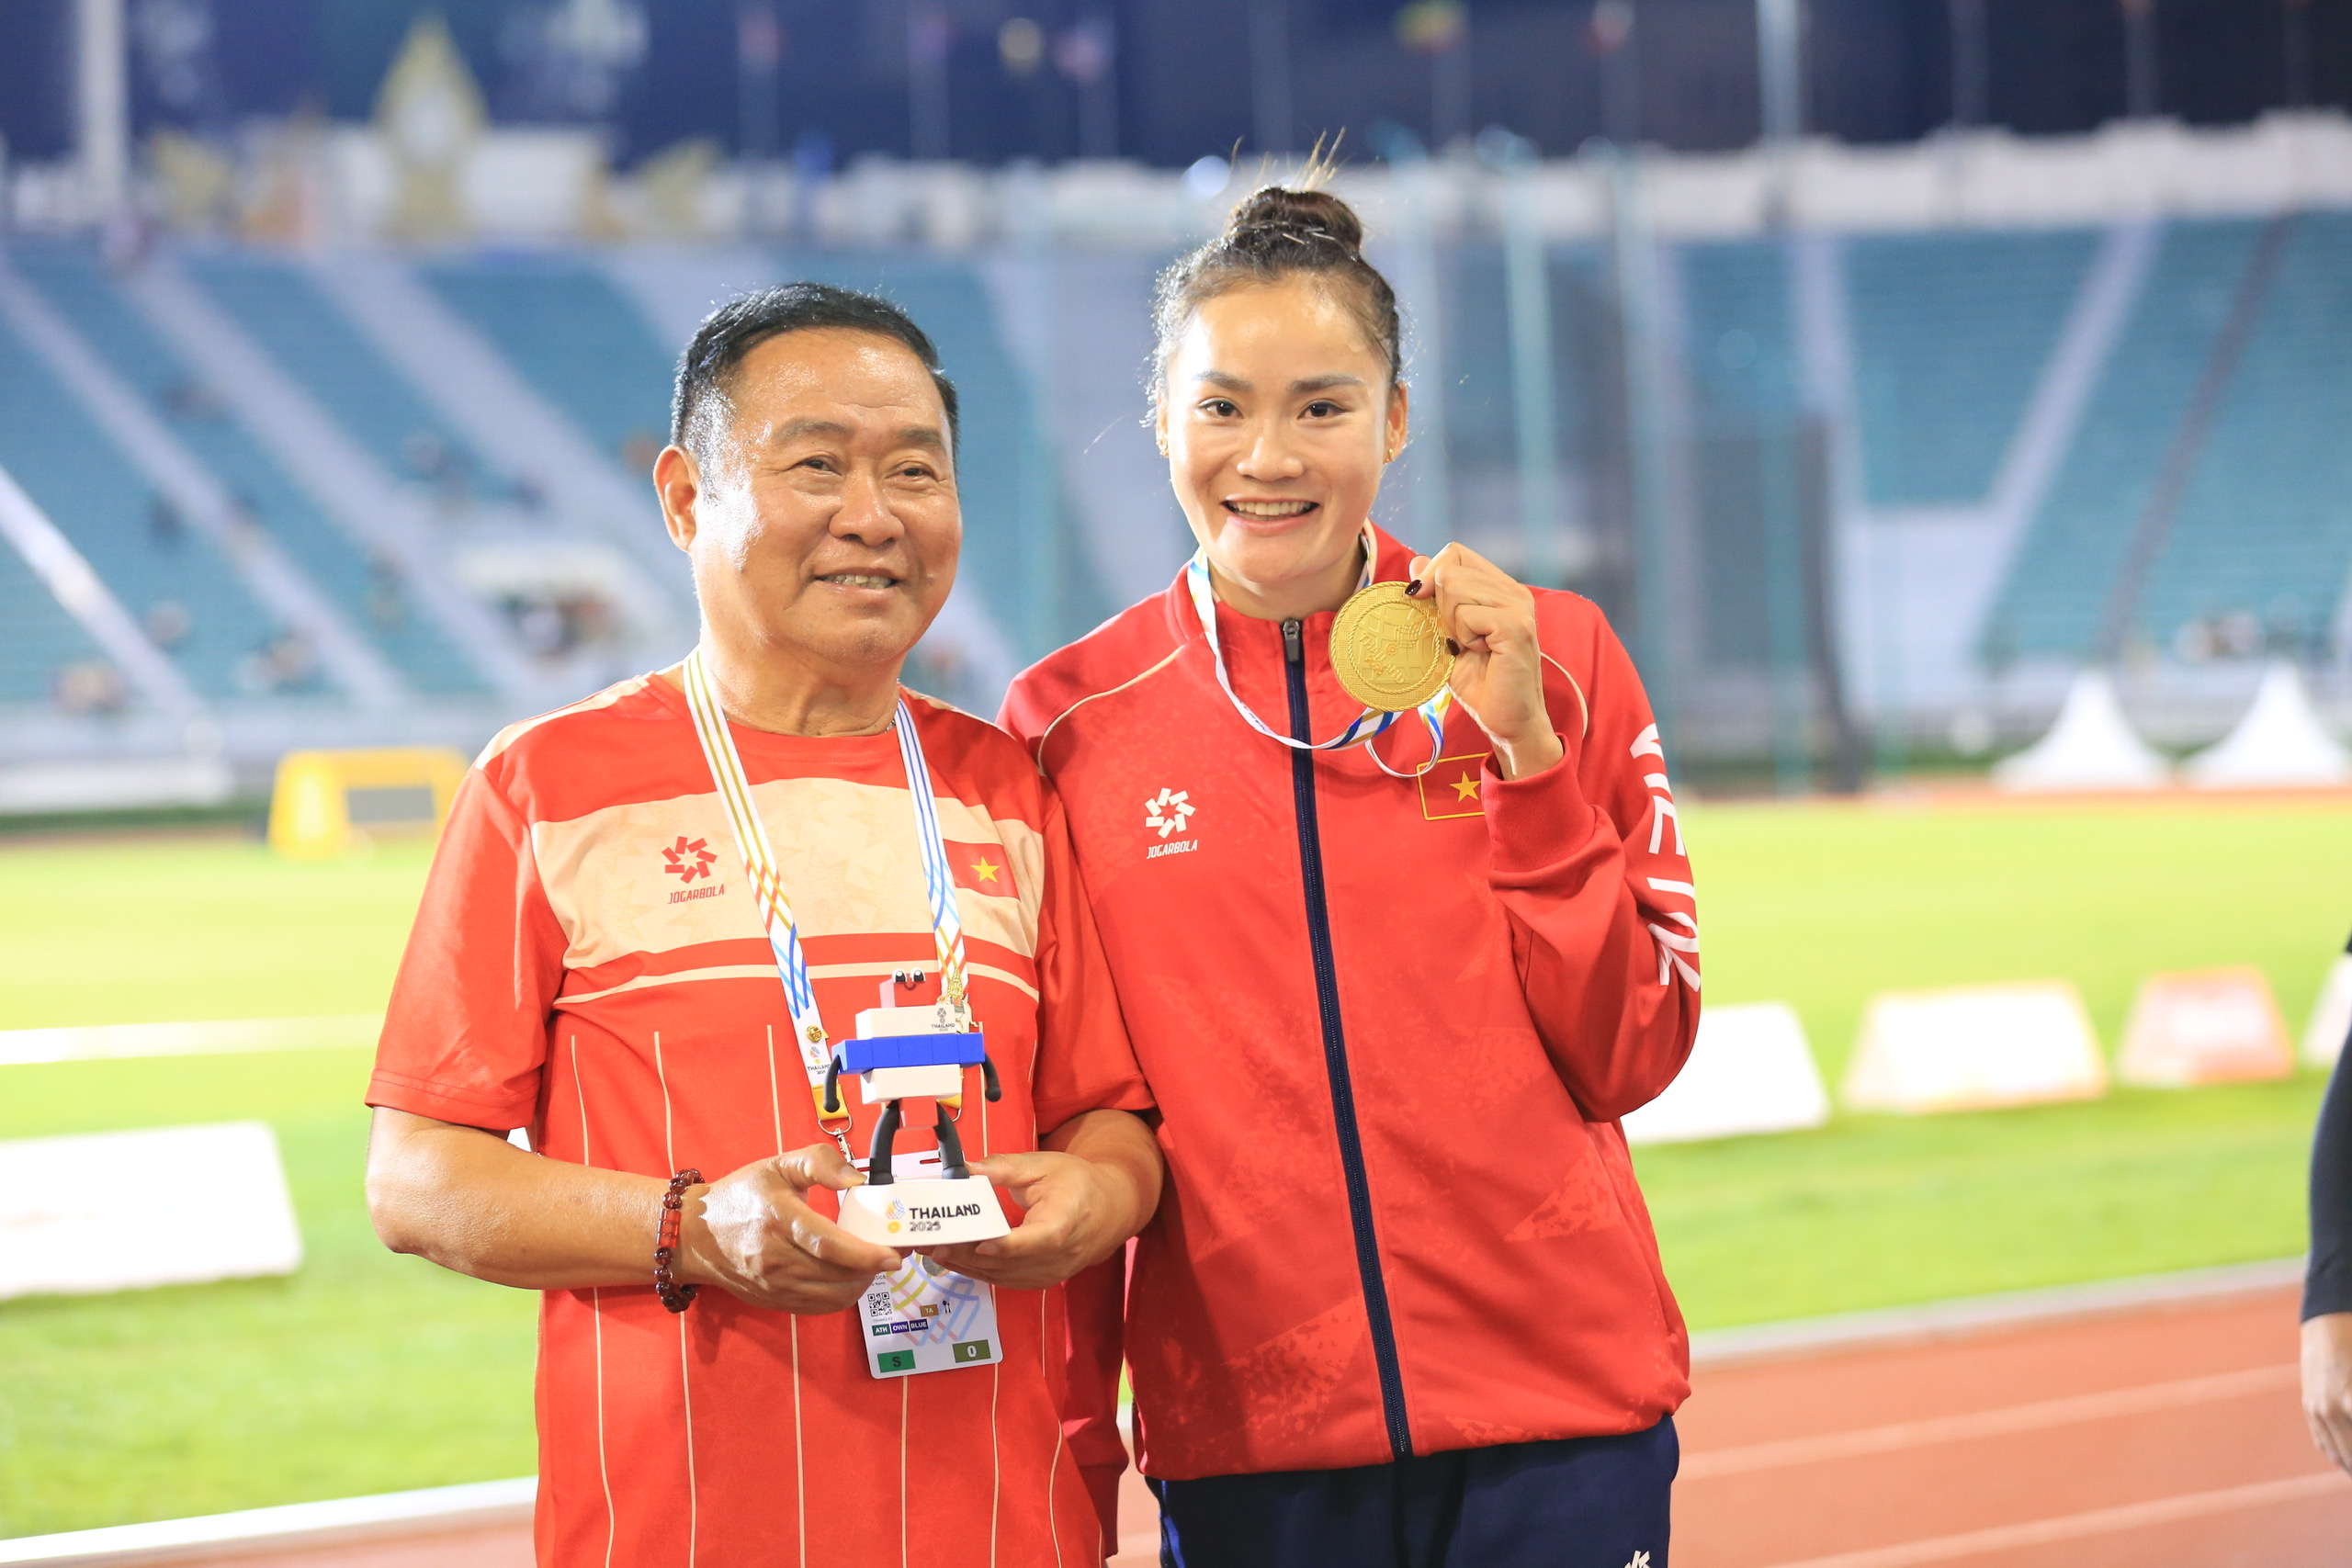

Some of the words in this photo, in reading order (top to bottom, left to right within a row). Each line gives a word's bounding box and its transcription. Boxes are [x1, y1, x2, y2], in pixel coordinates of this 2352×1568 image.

[1146, 839, 1198, 860] JOGARBOLA
[667, 883, 725, 905] JOGARBOLA
[909, 1203, 981, 1220] THAILAND
[909, 1220, 942, 1232] 2025
[892, 1324, 908, 1332] OWN
[910, 1321, 927, 1329] BLUE
[891, 1356, 902, 1368] S
